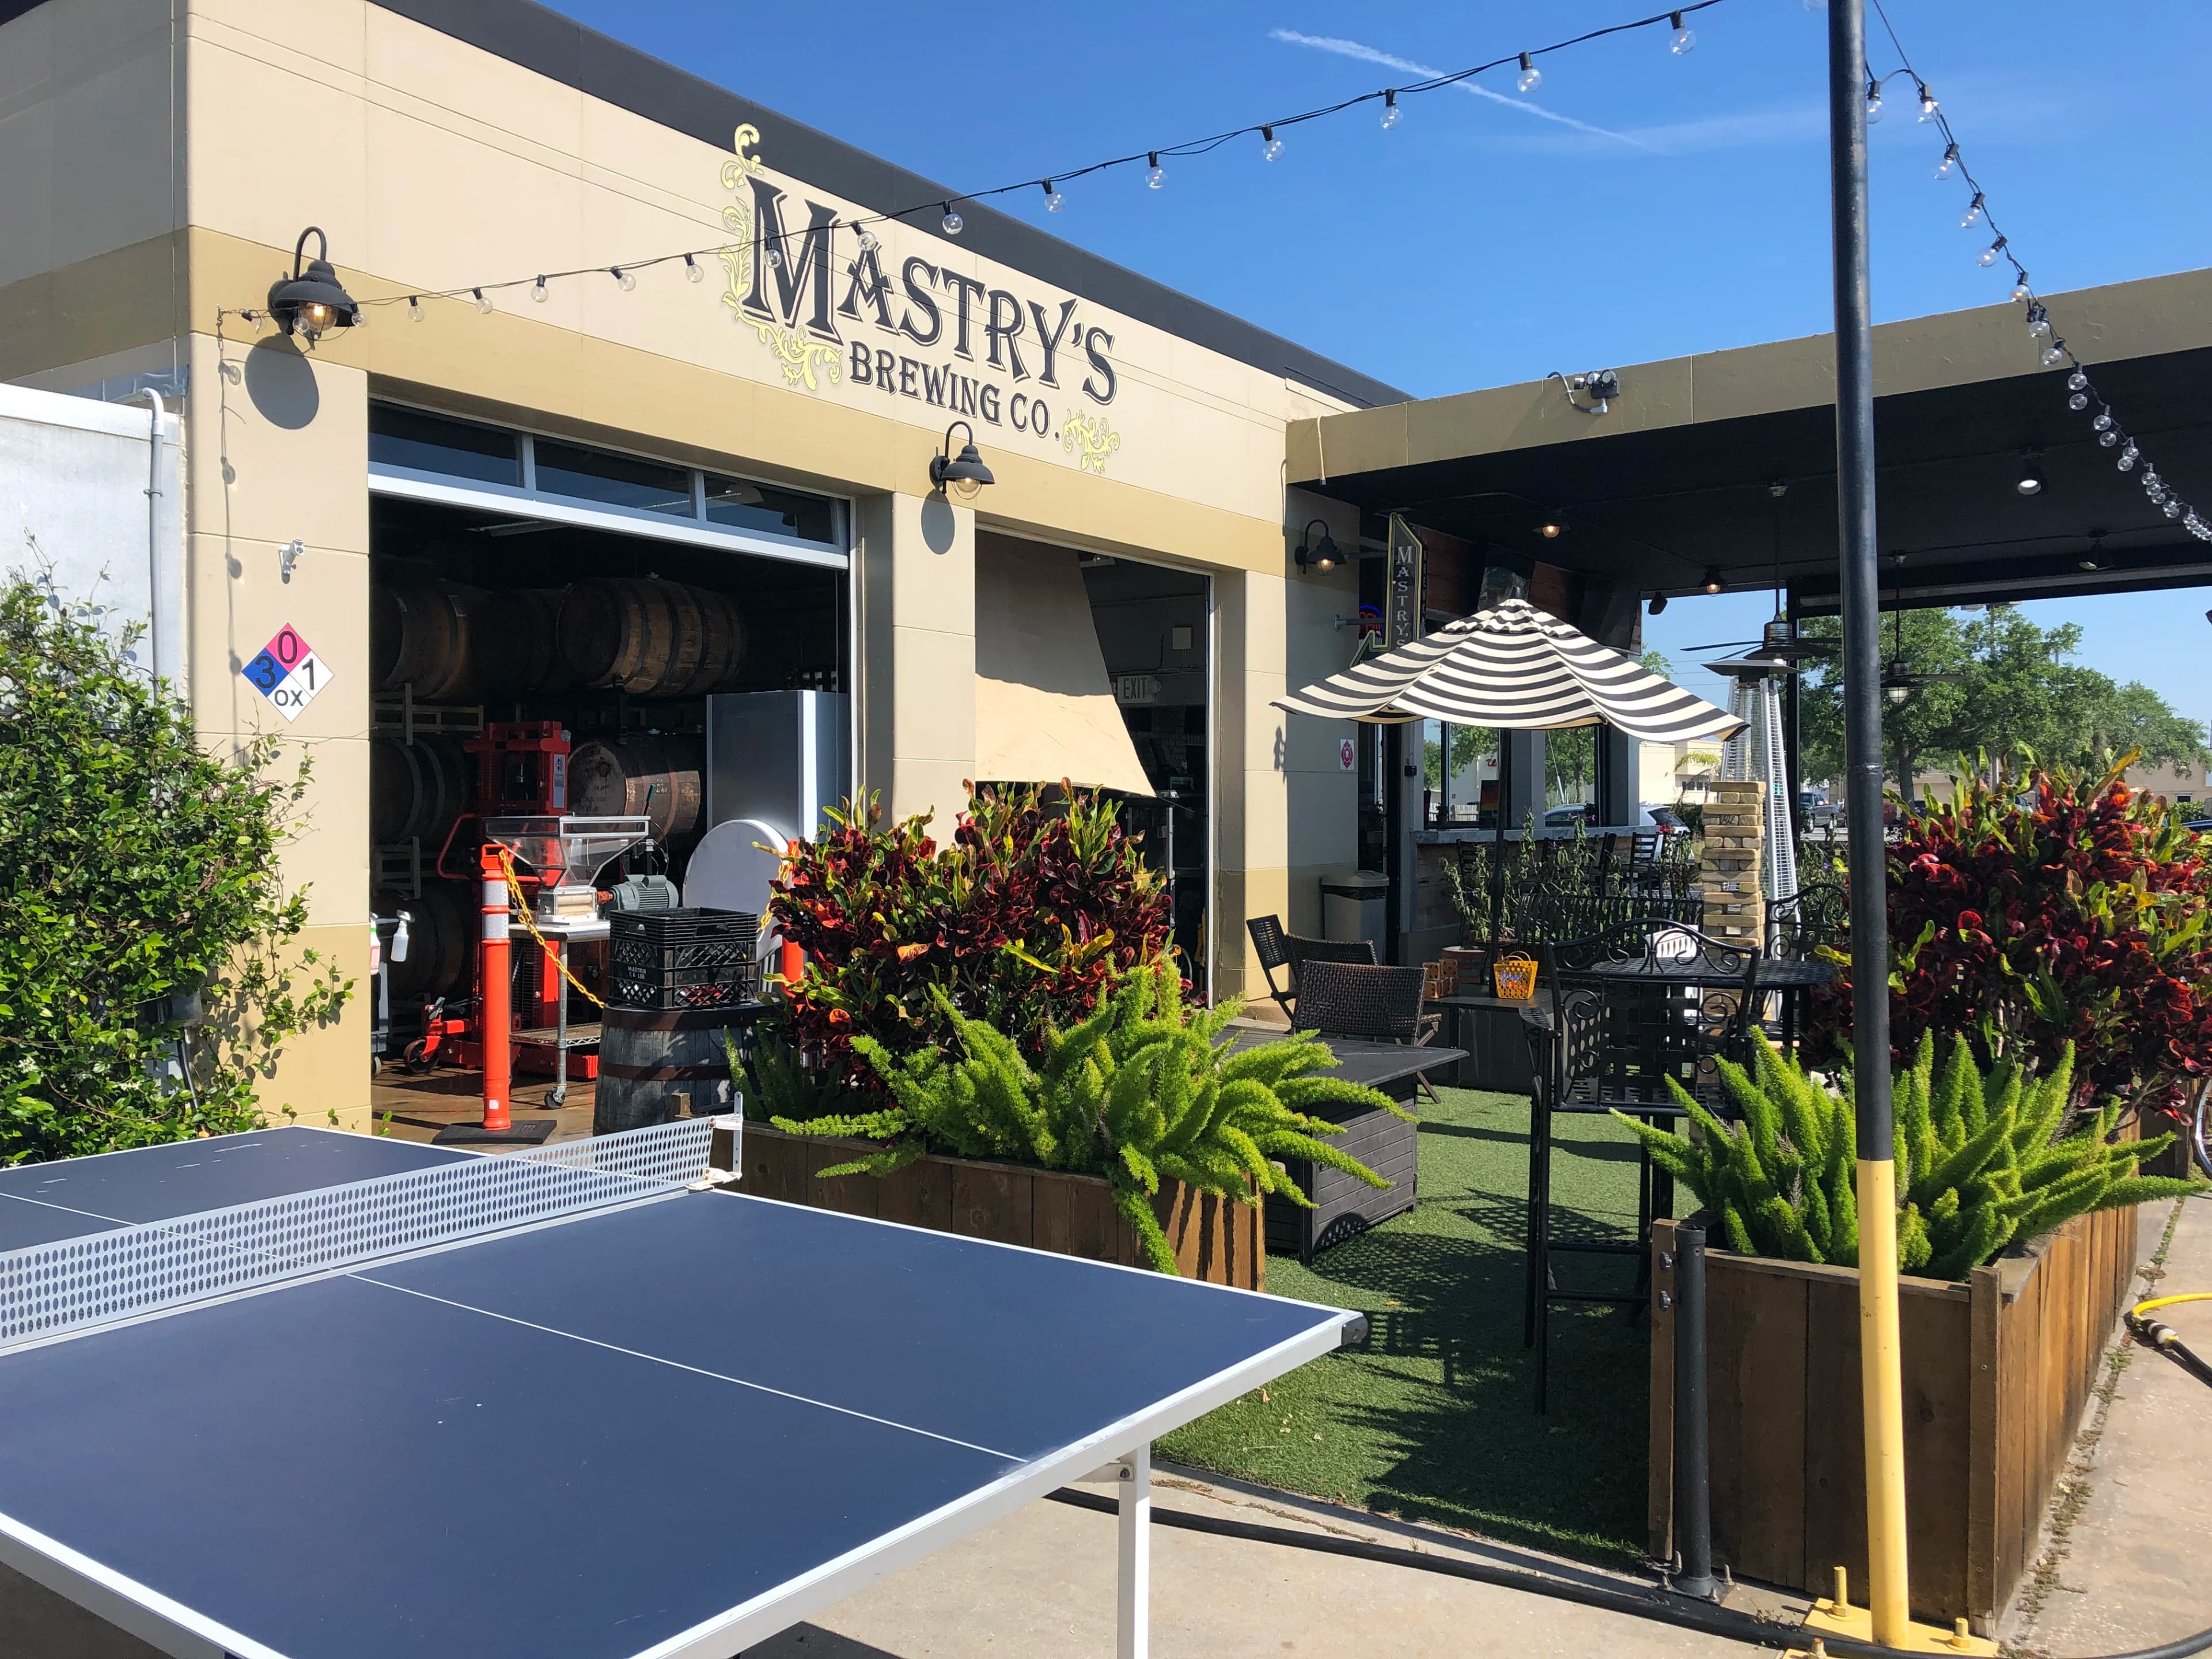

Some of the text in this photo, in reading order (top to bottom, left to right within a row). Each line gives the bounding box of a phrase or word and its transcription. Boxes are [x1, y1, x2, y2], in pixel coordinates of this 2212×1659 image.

[741, 174, 1116, 405] MASTRY'S
[850, 340, 1060, 441] BREWING CO.
[1396, 546, 1414, 649] MASTRY'S
[255, 656, 315, 690] 3 1
[278, 630, 297, 664] 0
[1123, 677, 1147, 699] EXIT
